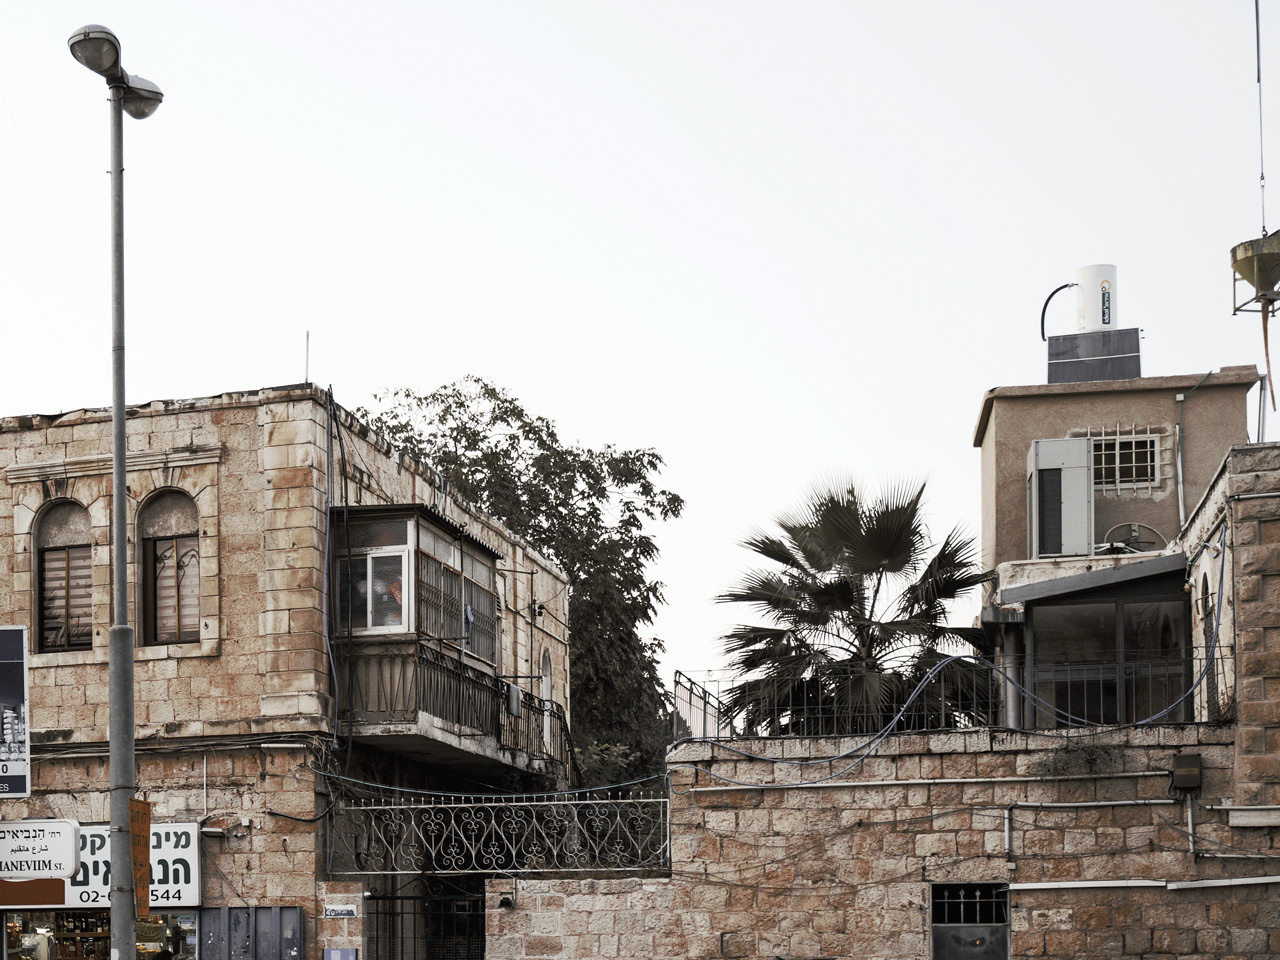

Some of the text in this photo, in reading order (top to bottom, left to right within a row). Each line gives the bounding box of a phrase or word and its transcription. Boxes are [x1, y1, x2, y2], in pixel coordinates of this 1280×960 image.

[48, 831, 61, 839] רח'
[32, 844, 49, 855] شارع
[54, 862, 65, 871] ST.
[71, 858, 191, 886] הנים
[80, 889, 183, 903] 02-544
